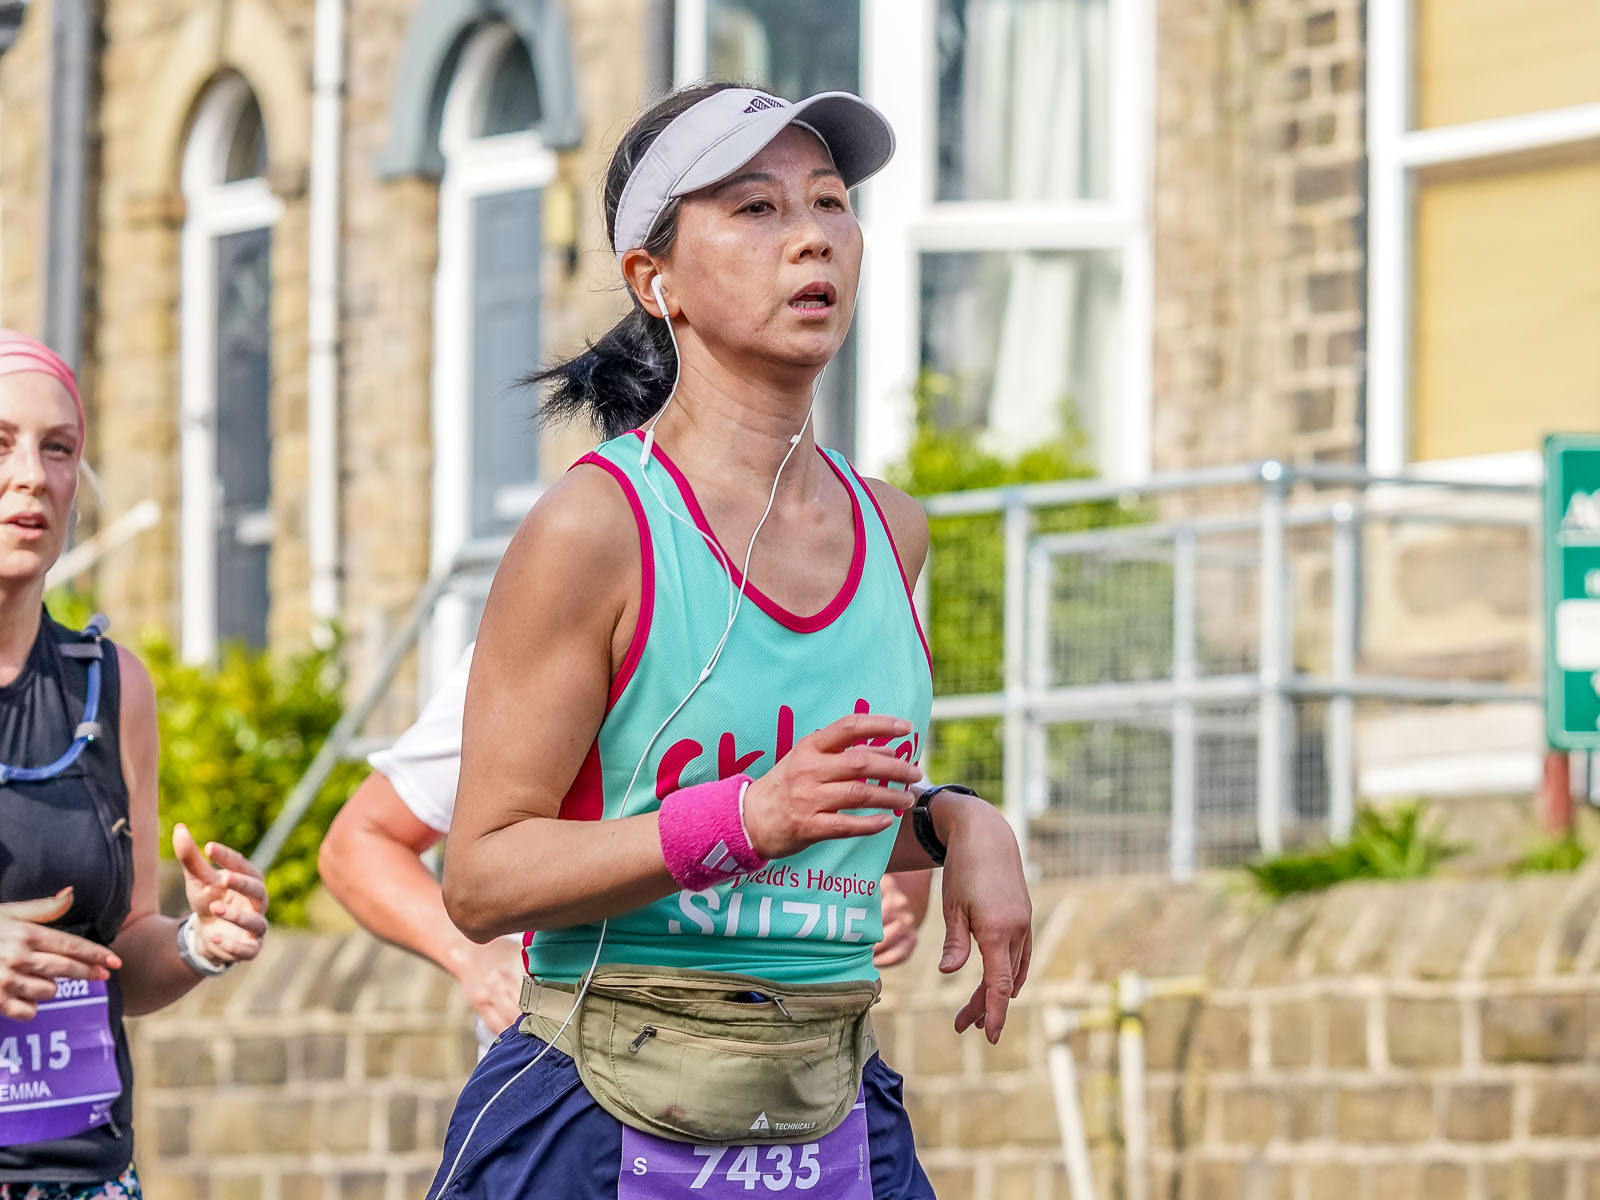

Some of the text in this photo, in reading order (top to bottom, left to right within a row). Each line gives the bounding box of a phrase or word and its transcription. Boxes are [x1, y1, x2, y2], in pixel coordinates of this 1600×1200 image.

[806, 868, 876, 899] Hospice
[0, 1080, 52, 1102] EMMA
[775, 1121, 816, 1131] TECHNICALS
[632, 1157, 648, 1176] S
[689, 1143, 821, 1191] 7435
